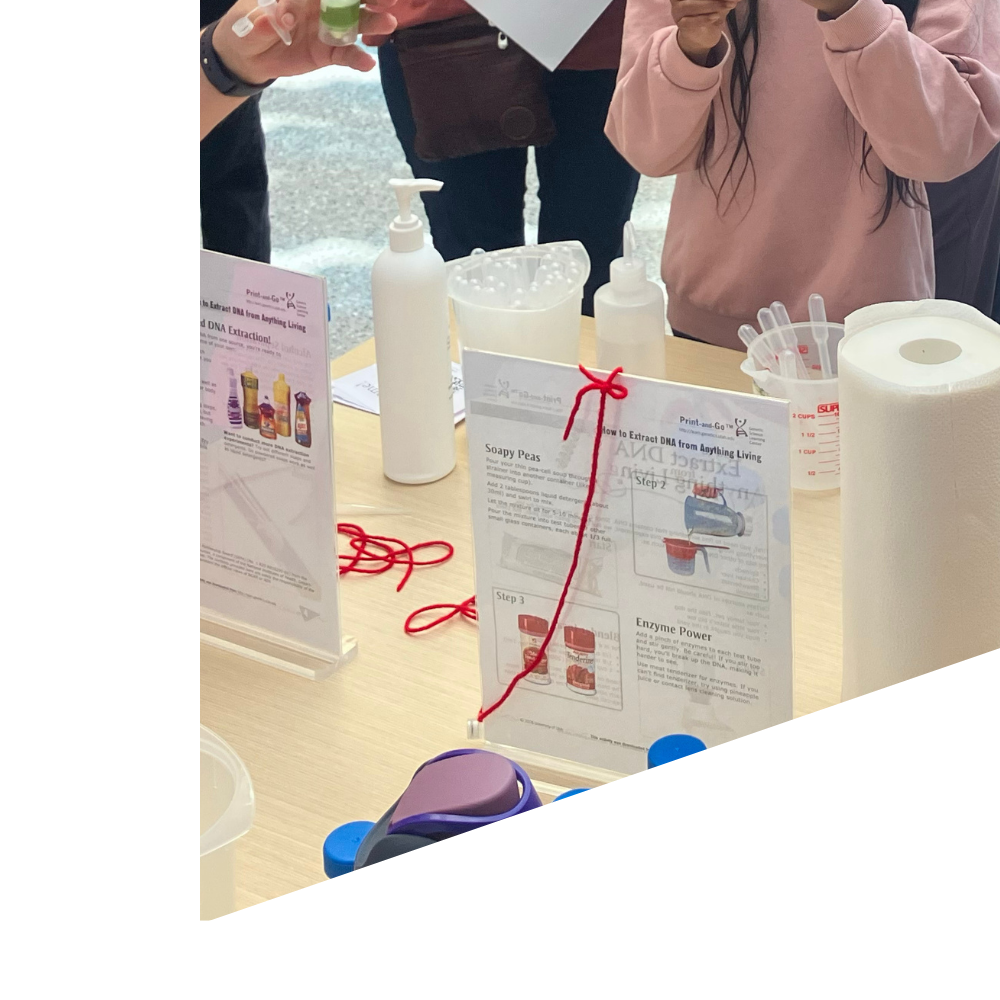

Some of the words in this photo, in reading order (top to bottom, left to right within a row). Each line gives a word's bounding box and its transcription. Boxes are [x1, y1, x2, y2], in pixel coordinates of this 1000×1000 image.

[202, 298, 208, 307] to
[210, 300, 231, 313] Extract
[232, 306, 244, 317] DNA
[246, 309, 260, 320] from
[261, 313, 286, 329] Anything
[287, 319, 307, 334] Living
[208, 319, 226, 333] DNA
[228, 324, 270, 345] Extraction!
[679, 414, 725, 431] Print-and-Go
[485, 443, 515, 460] Soapy
[517, 448, 541, 463] Peas
[618, 428, 627, 438] to
[628, 429, 658, 444] Extract
[660, 435, 676, 447] DNA
[677, 438, 698, 451] from
[700, 442, 734, 459] Anything
[736, 449, 762, 464] Living
[636, 476, 658, 489] Step
[660, 480, 666, 490] 2
[496, 591, 517, 603] Step
[519, 595, 525, 604] 3
[636, 616, 676, 637] Enzyme
[678, 625, 713, 643] Power
[636, 630, 648, 638] Add
[680, 640, 708, 652] enzymes
[717, 648, 732, 657] each
[733, 652, 745, 660] test
[746, 655, 760, 663] tube
[636, 651, 657, 661] harder
[636, 660, 648, 669] Use
[671, 652, 688, 661] break
[690, 657, 699, 665] up
[700, 658, 710, 666] the
[653, 671, 664, 679] find
[711, 684, 728, 694] using
[730, 688, 760, 700] pineapple
[661, 680, 684, 690] contact
[685, 684, 698, 693] lens
[698, 687, 724, 699] cleaning
